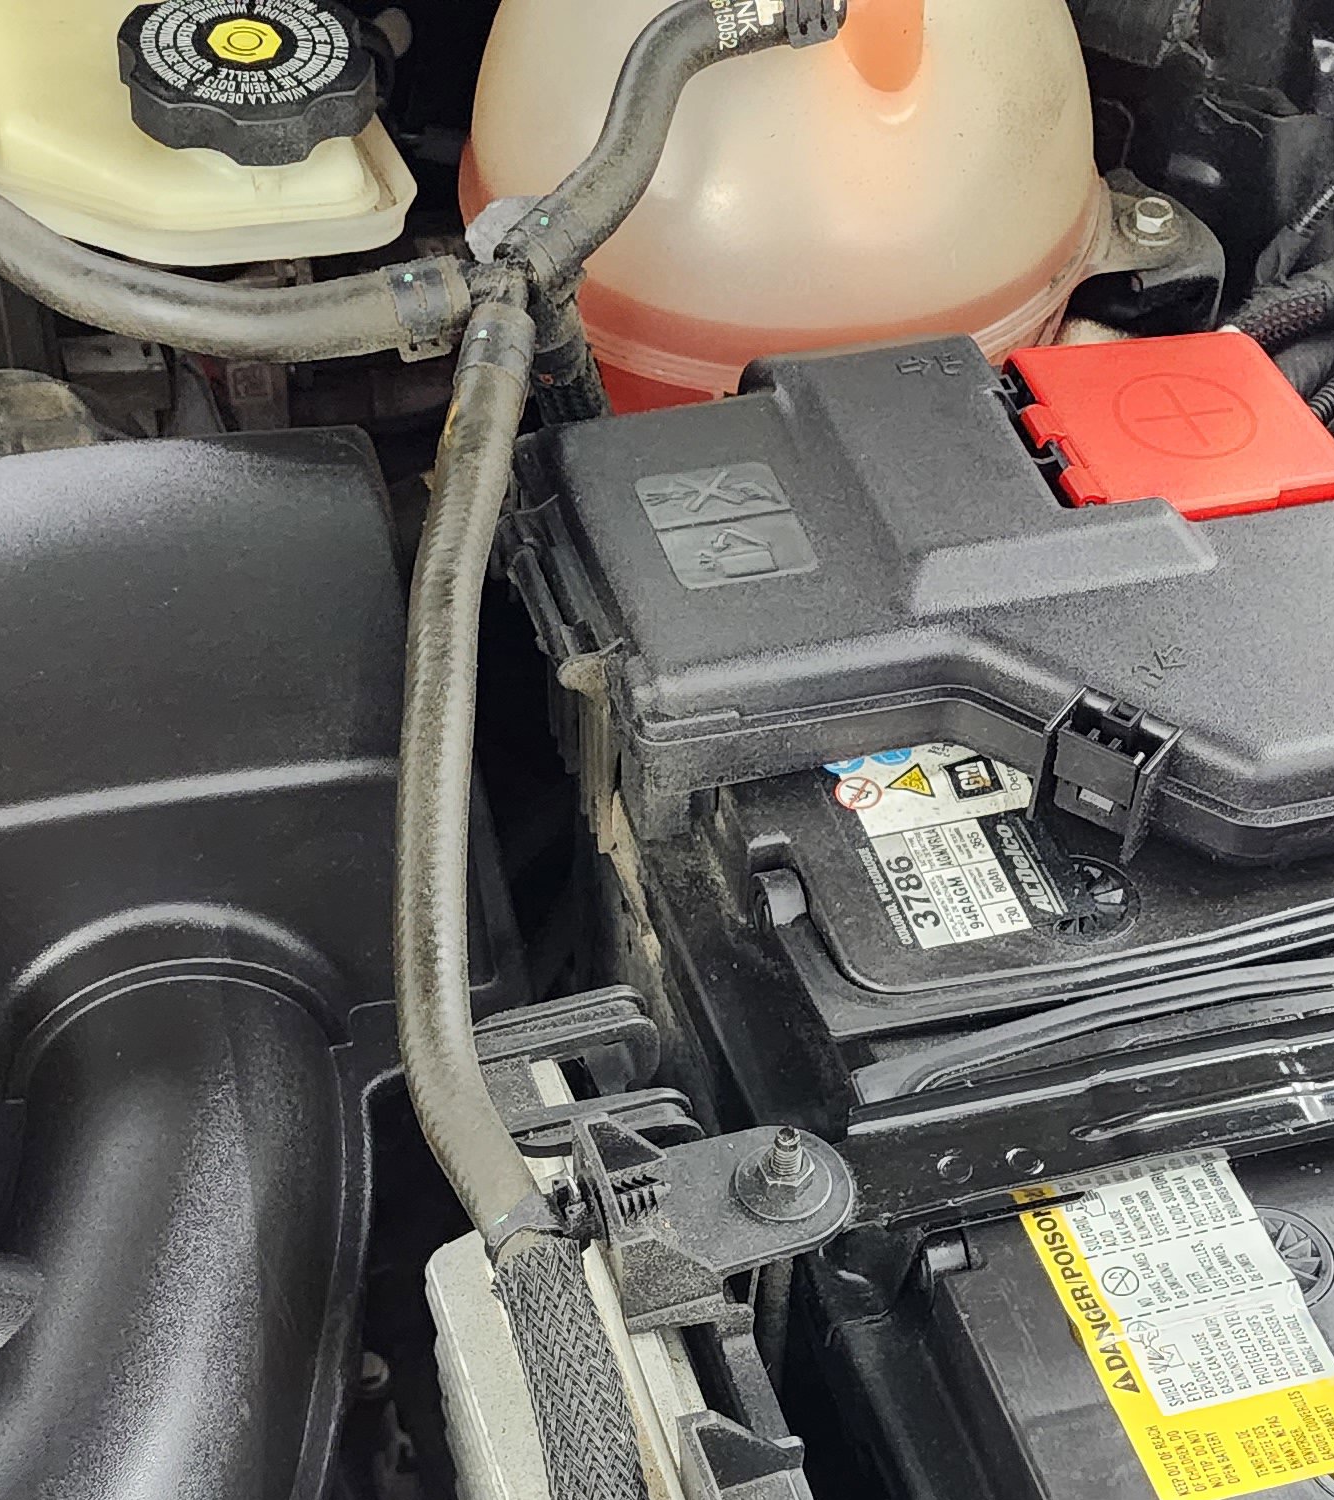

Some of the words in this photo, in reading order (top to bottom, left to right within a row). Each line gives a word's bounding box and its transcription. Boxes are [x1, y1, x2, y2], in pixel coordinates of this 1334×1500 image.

[186, 2, 246, 25] WARNING:
[253, 4, 314, 41] PROVENANT
[172, 21, 201, 45] CLEAN
[309, 26, 330, 43] QUE
[314, 9, 348, 45] NETTOYER
[177, 46, 214, 74] FILLER
[292, 40, 313, 61] D'UN
[314, 44, 331, 55] DU
[331, 48, 350, 59] LE
[160, 49, 182, 65] USE
[171, 61, 204, 82] ONLY
[267, 56, 306, 80] BIDON
[291, 54, 329, 82] LIQUIDE
[302, 58, 347, 92] BOUCHON
[198, 75, 236, 93] DOT3
[240, 78, 280, 94] FREIN
[275, 75, 299, 89] DE
[247, 93, 267, 104] LA
[267, 84, 311, 104] AVANT
[952, 761, 987, 790] GM
[965, 830, 985, 849] 365
[990, 822, 1054, 915] ACDelco
[984, 867, 1007, 892] 80Ah
[883, 854, 943, 930] 3786
[946, 875, 985, 930] 94RAGM
[1003, 905, 1023, 925] 730
[889, 914, 914, 944] CATALOG
[1171, 1175, 1186, 1185] LA
[1191, 1177, 1207, 1191] DES
[1200, 1161, 1223, 1187] GRAVES
[1119, 1194, 1134, 1205] OR
[1135, 1189, 1156, 1212] BURNS
[1198, 1190, 1213, 1200] OU
[1108, 1208, 1128, 1230] CAUSE
[1124, 1204, 1152, 1240] BLINDNESS
[1146, 1211, 1169, 1236] SEVERE
[1165, 1202, 1191, 1231] L'ACIDE
[1189, 1209, 1208, 1227] PEUT
[1072, 1215, 1102, 1252] SULFURIC
[1098, 1229, 1119, 1248] ACID
[1118, 1229, 1135, 1243] CAN
[1132, 1251, 1156, 1279] FLAMES
[1233, 1251, 1257, 1274] FUMER
[1156, 1261, 1183, 1291] SMOKING
[1212, 1277, 1229, 1290] LES
[1229, 1273, 1246, 1286] LES
[1248, 1272, 1263, 1282] DE
[1136, 1296, 1154, 1308] NO
[1174, 1289, 1189, 1299] OR
[1230, 1327, 1251, 1344] LES
[1245, 1313, 1275, 1352] EXPLOSIFS
[1264, 1314, 1290, 1346] BLESSER
[1282, 1312, 1309, 1346] AVEUGLE
[1191, 1331, 1213, 1356] CAUSE
[1215, 1339, 1231, 1351] OR
[1203, 1354, 1222, 1370] CAN
[1220, 1349, 1251, 1390] BLINDNESS
[1236, 1342, 1273, 1386] PROTÉGEZ
[1265, 1351, 1283, 1367] GAZ
[1280, 1344, 1308, 1377] PEUVENT
[1298, 1344, 1325, 1374] RENDRE
[1187, 1359, 1217, 1399] EXPLOSIVE
[1211, 1369, 1234, 1394] GASES
[1273, 1366, 1290, 1380] LES
[1156, 1376, 1185, 1407] SHIELD
[1179, 1381, 1202, 1402] EYES
[1286, 1389, 1321, 1433] COUVERCLES
[1314, 1403, 1329, 1413] ET
[1251, 1424, 1269, 1439] DES
[1264, 1414, 1282, 1429] PAS
[1144, 1424, 1167, 1449] REACH
[1165, 1429, 1182, 1441] DO
[1183, 1428, 1201, 1444] NOT
[1235, 1429, 1250, 1439] DE
[1271, 1428, 1287, 1438] NE
[1157, 1450, 1173, 1460] OF
[1191, 1444, 1207, 1456] DO
[1203, 1430, 1230, 1463] BATTERY
[1311, 1431, 1334, 1461] GARDER
[1162, 1460, 1181, 1476] OUT
[1220, 1463, 1240, 1484] OPEN
[1249, 1457, 1270, 1477] TENIR
[1271, 1463, 1286, 1473] LA
[1171, 1476, 1191, 1496] KEEP
[1191, 1480, 1207, 1492] OF
[1205, 1471, 1224, 1488] NOT
